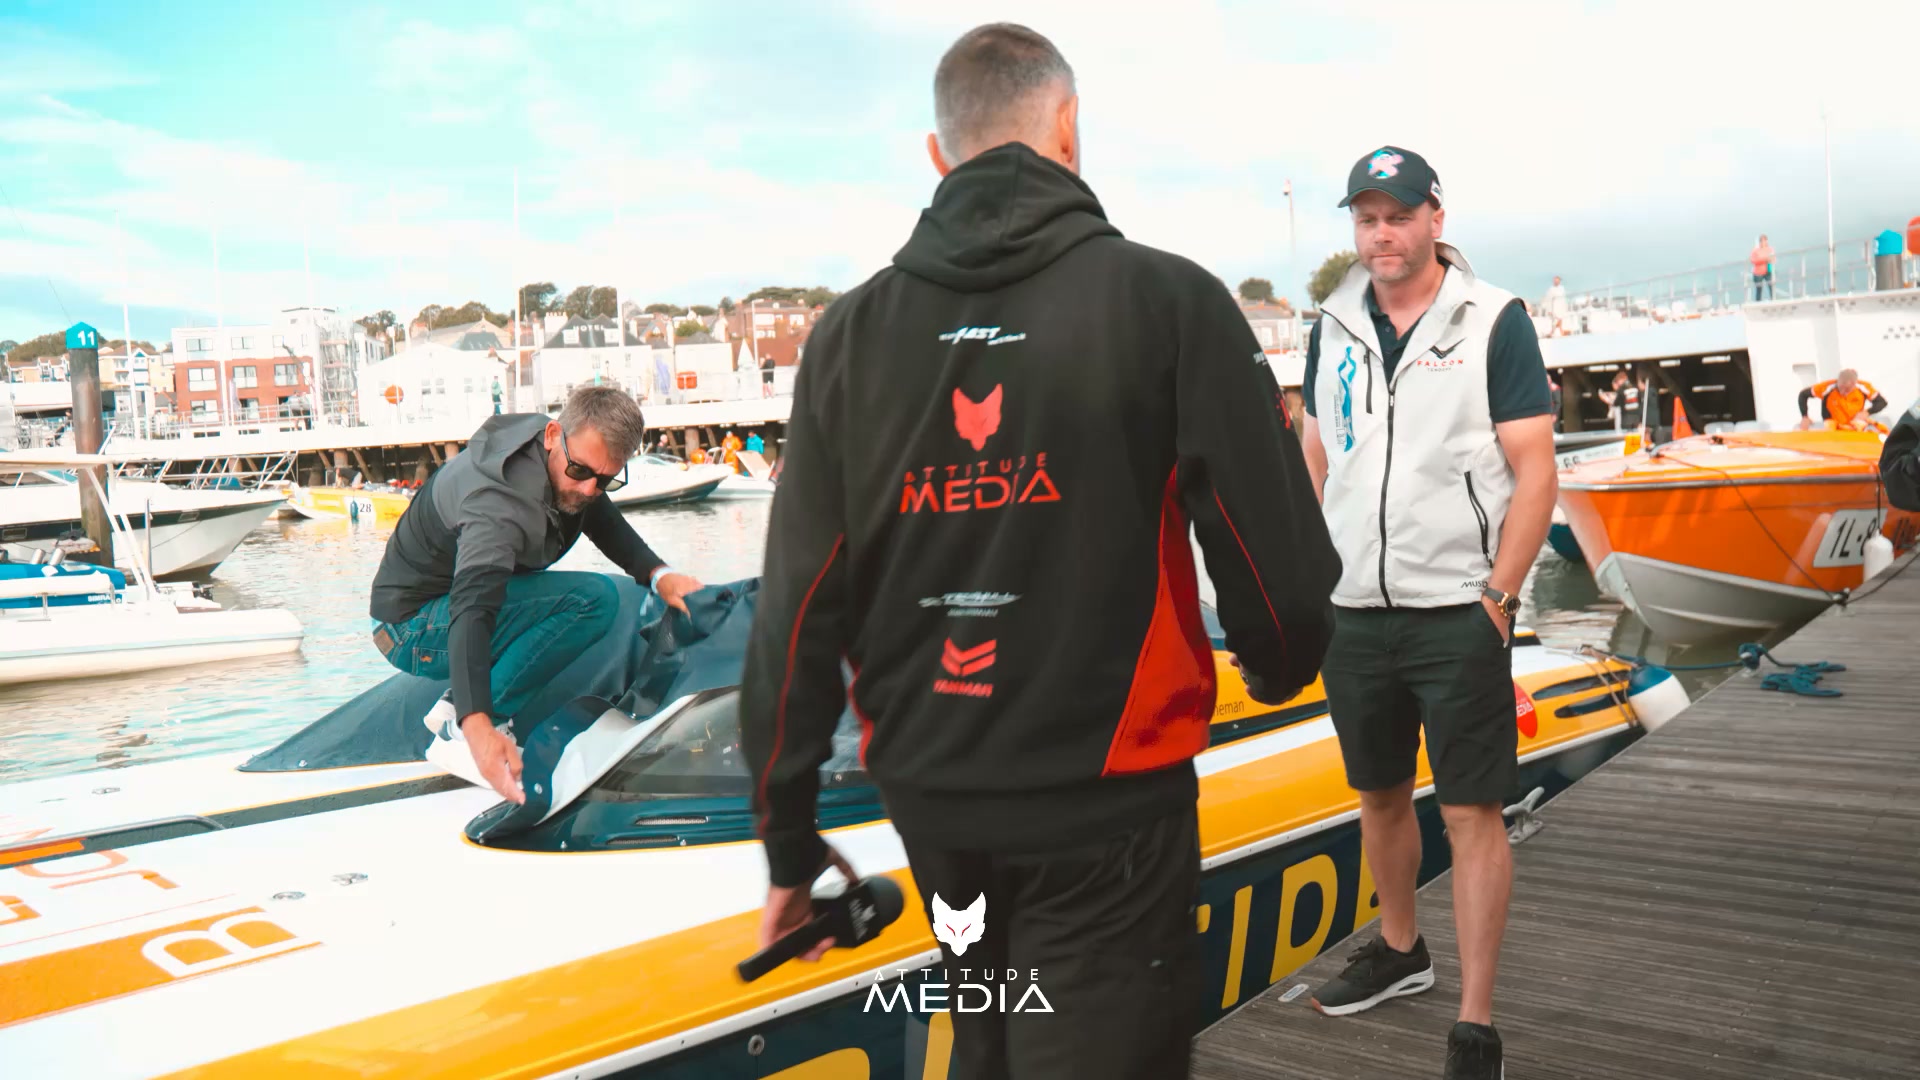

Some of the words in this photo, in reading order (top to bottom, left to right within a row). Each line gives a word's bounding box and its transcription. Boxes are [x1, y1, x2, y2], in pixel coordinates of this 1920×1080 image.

[77, 330, 95, 346] 11
[1416, 359, 1464, 367] FALCON
[899, 468, 1062, 514] MEDIA
